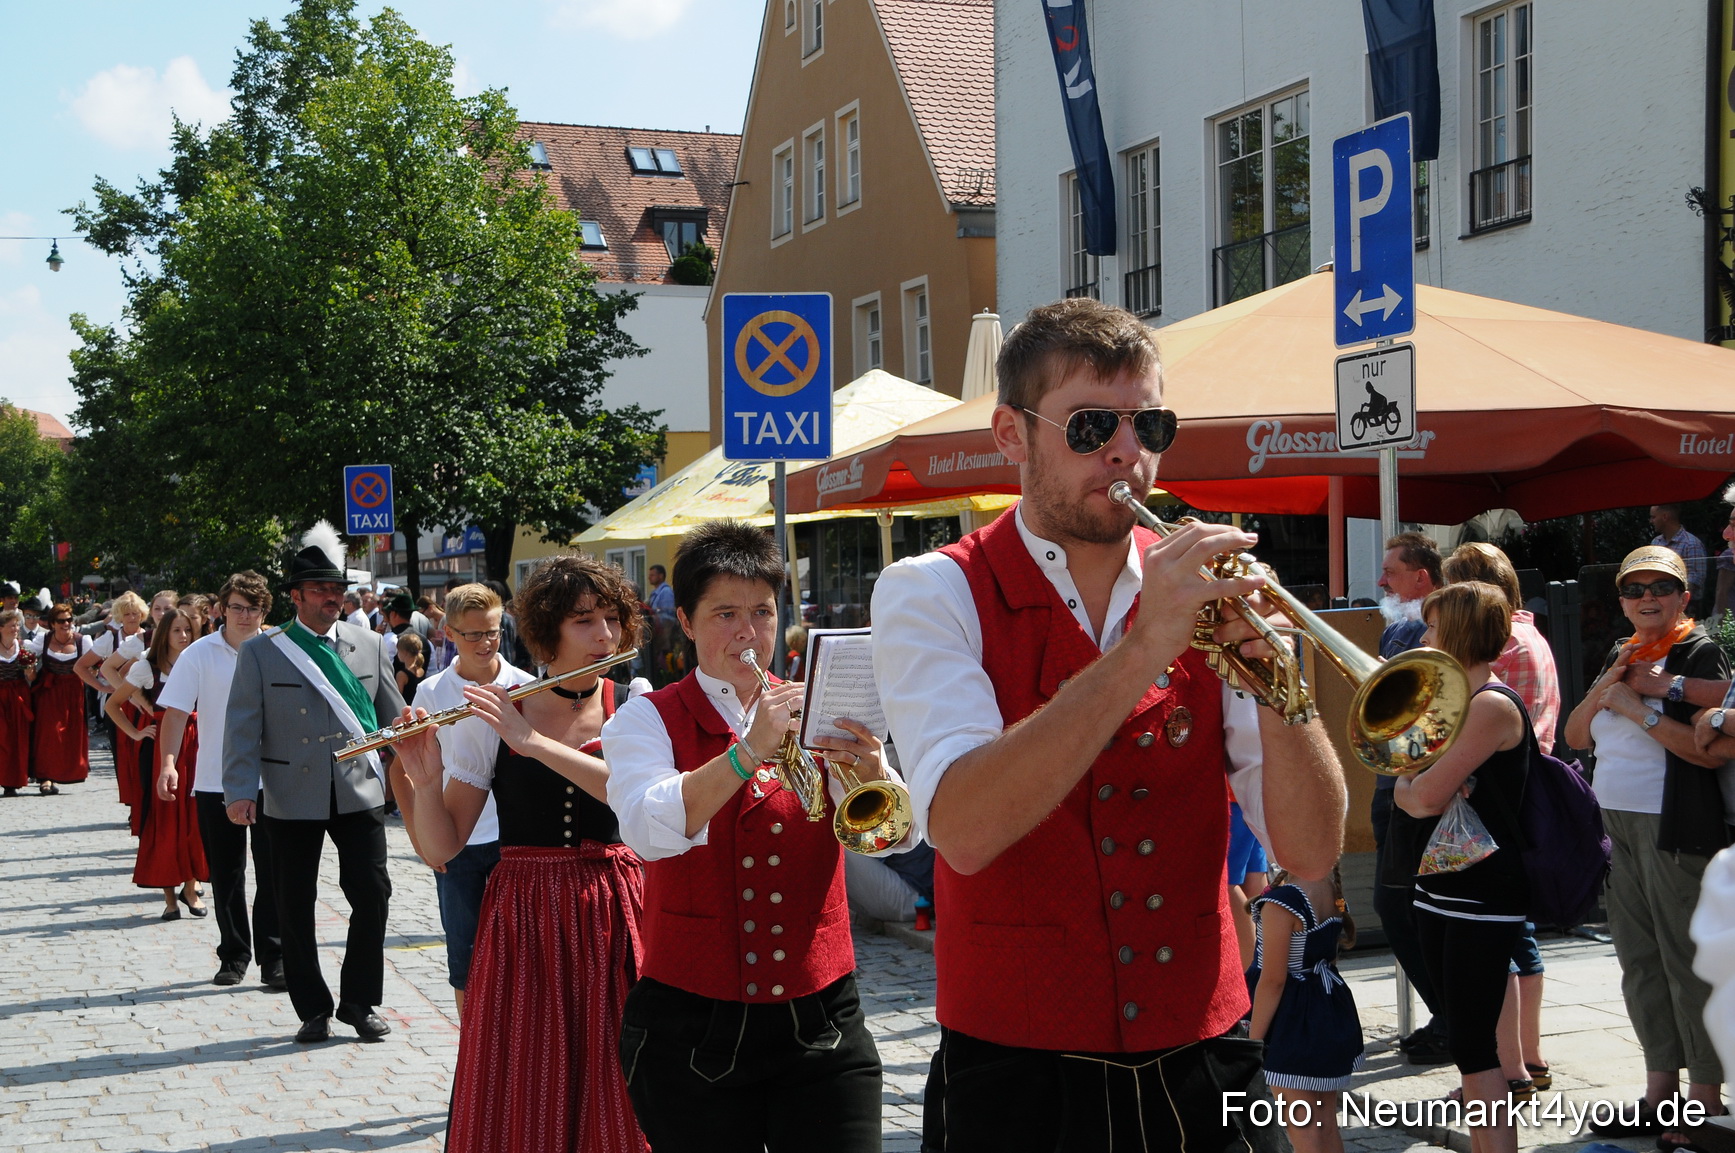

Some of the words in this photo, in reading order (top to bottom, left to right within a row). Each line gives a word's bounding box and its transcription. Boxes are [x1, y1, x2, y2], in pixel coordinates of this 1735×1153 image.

[1349, 149, 1393, 273] P
[1362, 359, 1387, 379] nur
[734, 412, 819, 445] TAXI
[1679, 433, 1735, 455] Hotel
[928, 455, 954, 476] Hotel
[956, 451, 1004, 472] Restaurant
[351, 513, 389, 529] TAXI
